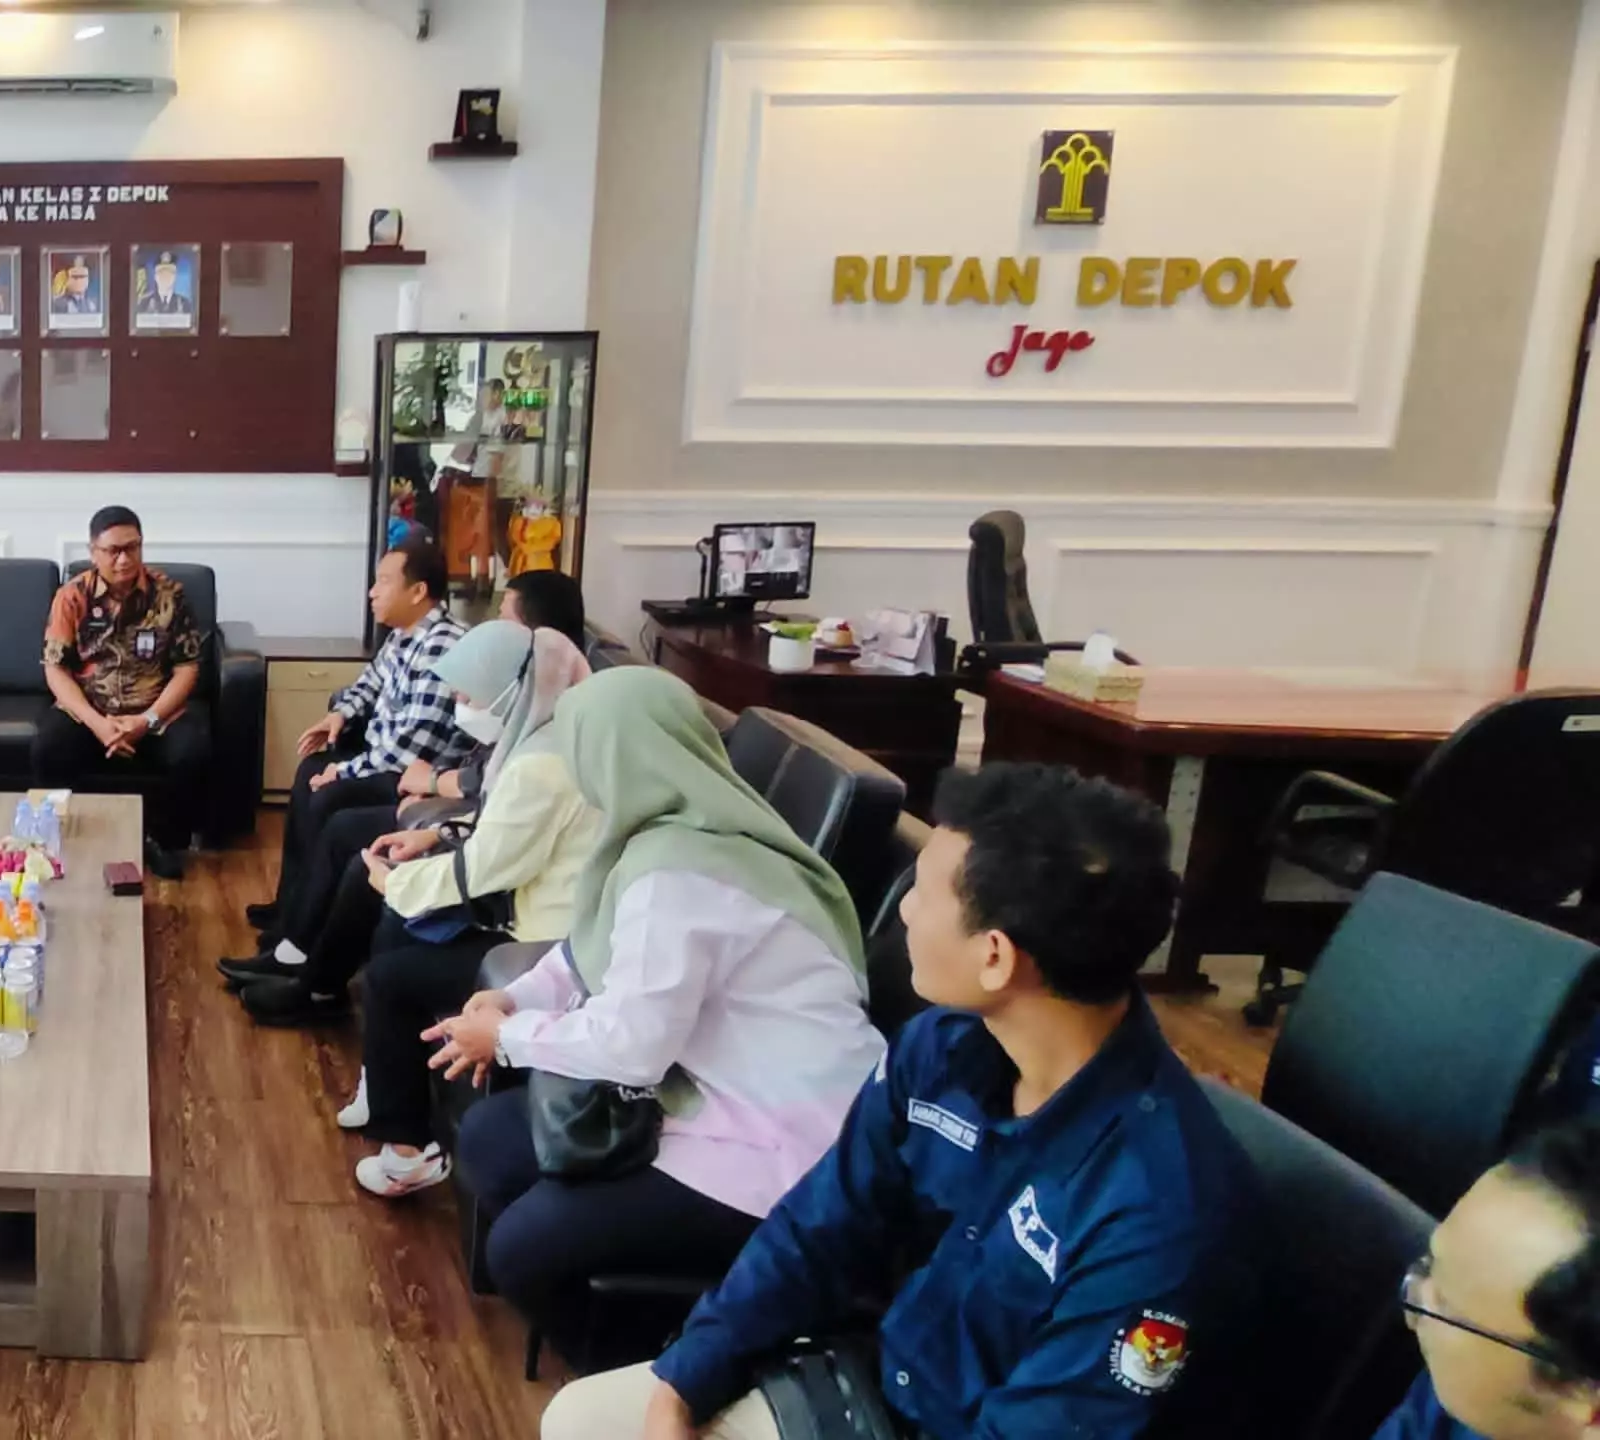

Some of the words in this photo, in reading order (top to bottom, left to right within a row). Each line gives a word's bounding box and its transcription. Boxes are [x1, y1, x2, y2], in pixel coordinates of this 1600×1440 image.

[20, 186, 84, 203] KELAS
[88, 186, 102, 203] I
[106, 185, 169, 203] DEPOK
[14, 205, 39, 221] KE
[44, 204, 96, 220] MASA
[831, 255, 1041, 305] RUTAN
[1076, 257, 1297, 308] DEPOK
